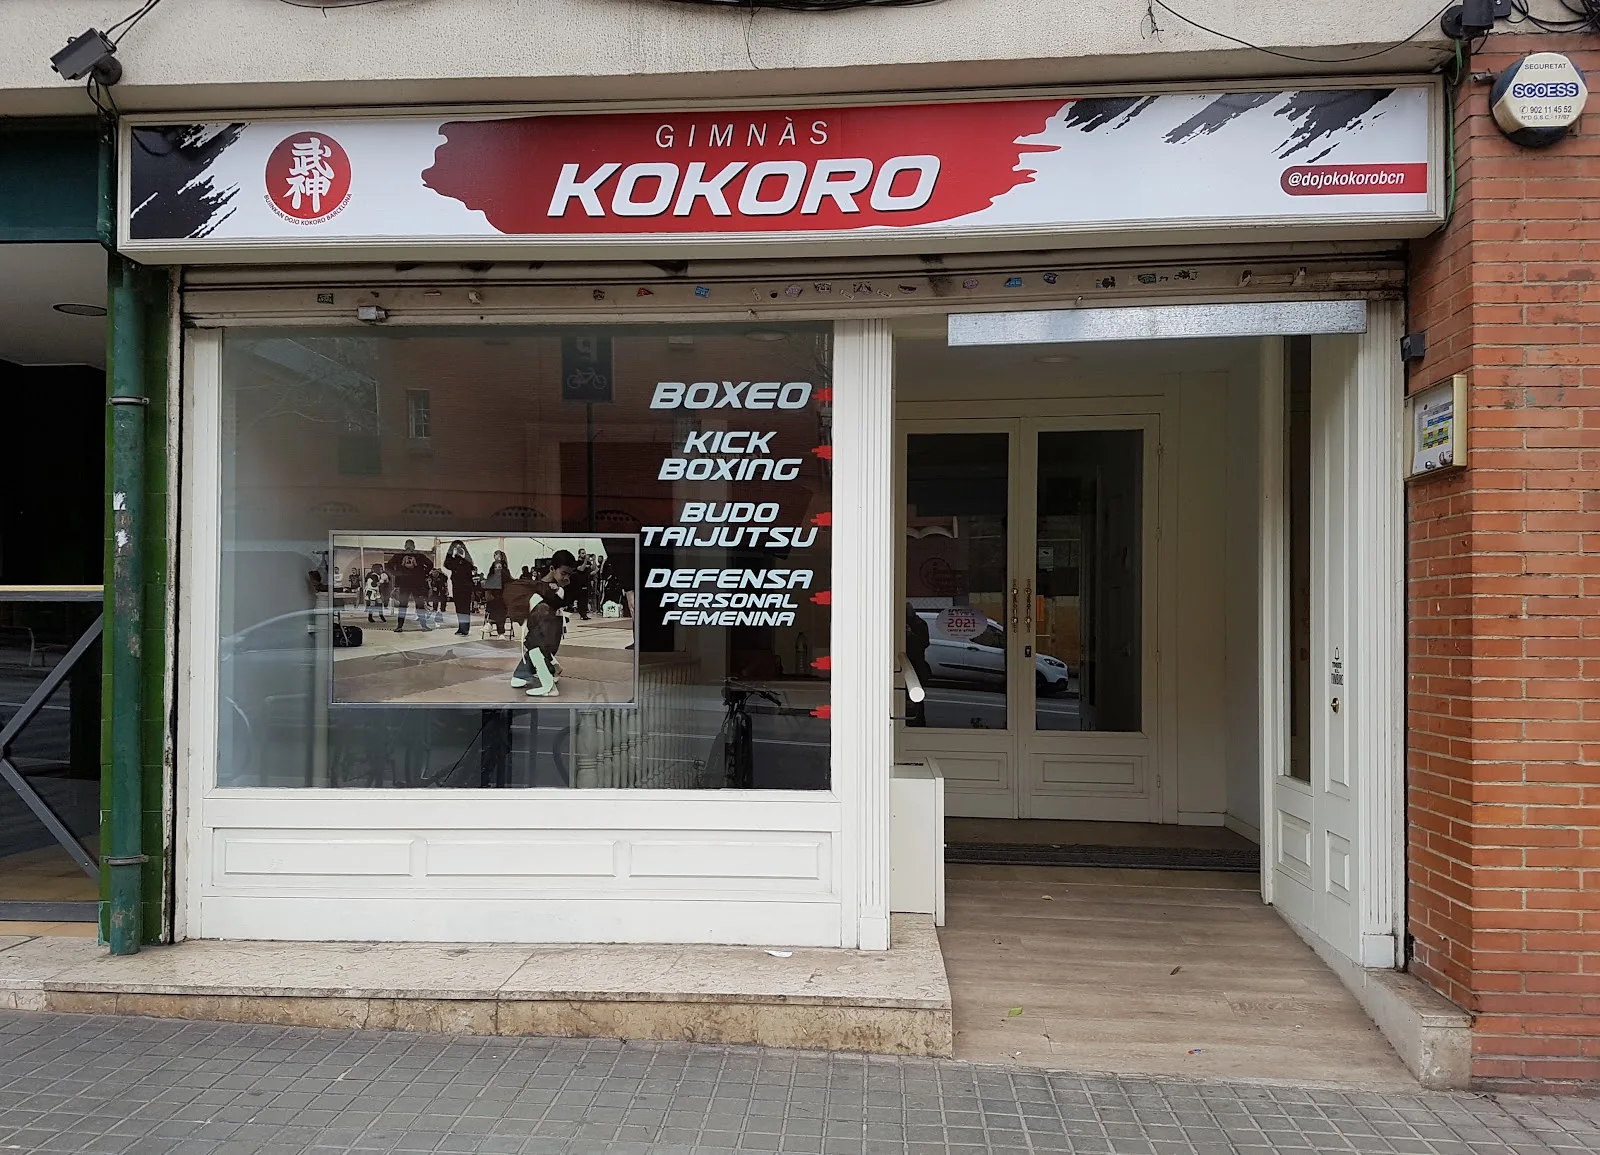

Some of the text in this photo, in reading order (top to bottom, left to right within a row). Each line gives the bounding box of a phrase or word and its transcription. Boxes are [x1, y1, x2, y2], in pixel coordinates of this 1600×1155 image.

[1513, 83, 1579, 98] SCOESS
[1530, 105, 1572, 114] 902 11 45 52
[655, 116, 829, 148] GIMNÀS
[283, 137, 335, 213] 武神
[547, 154, 941, 217] KOKORO
[1288, 170, 1405, 189] @dojokokorobcn
[263, 193, 353, 226] BUJINKAN DOJO KOKORO BARCELONA
[650, 381, 812, 409] BOXEO
[683, 431, 777, 454] KICK
[657, 458, 803, 481] BOXING
[679, 502, 780, 523] BUDO
[641, 526, 818, 548] TAIJUTSU
[645, 568, 814, 589] DEFENSA
[659, 592, 798, 609] PERSONAL
[661, 610, 796, 627] FEMENINA
[947, 618, 976, 628] 2021
